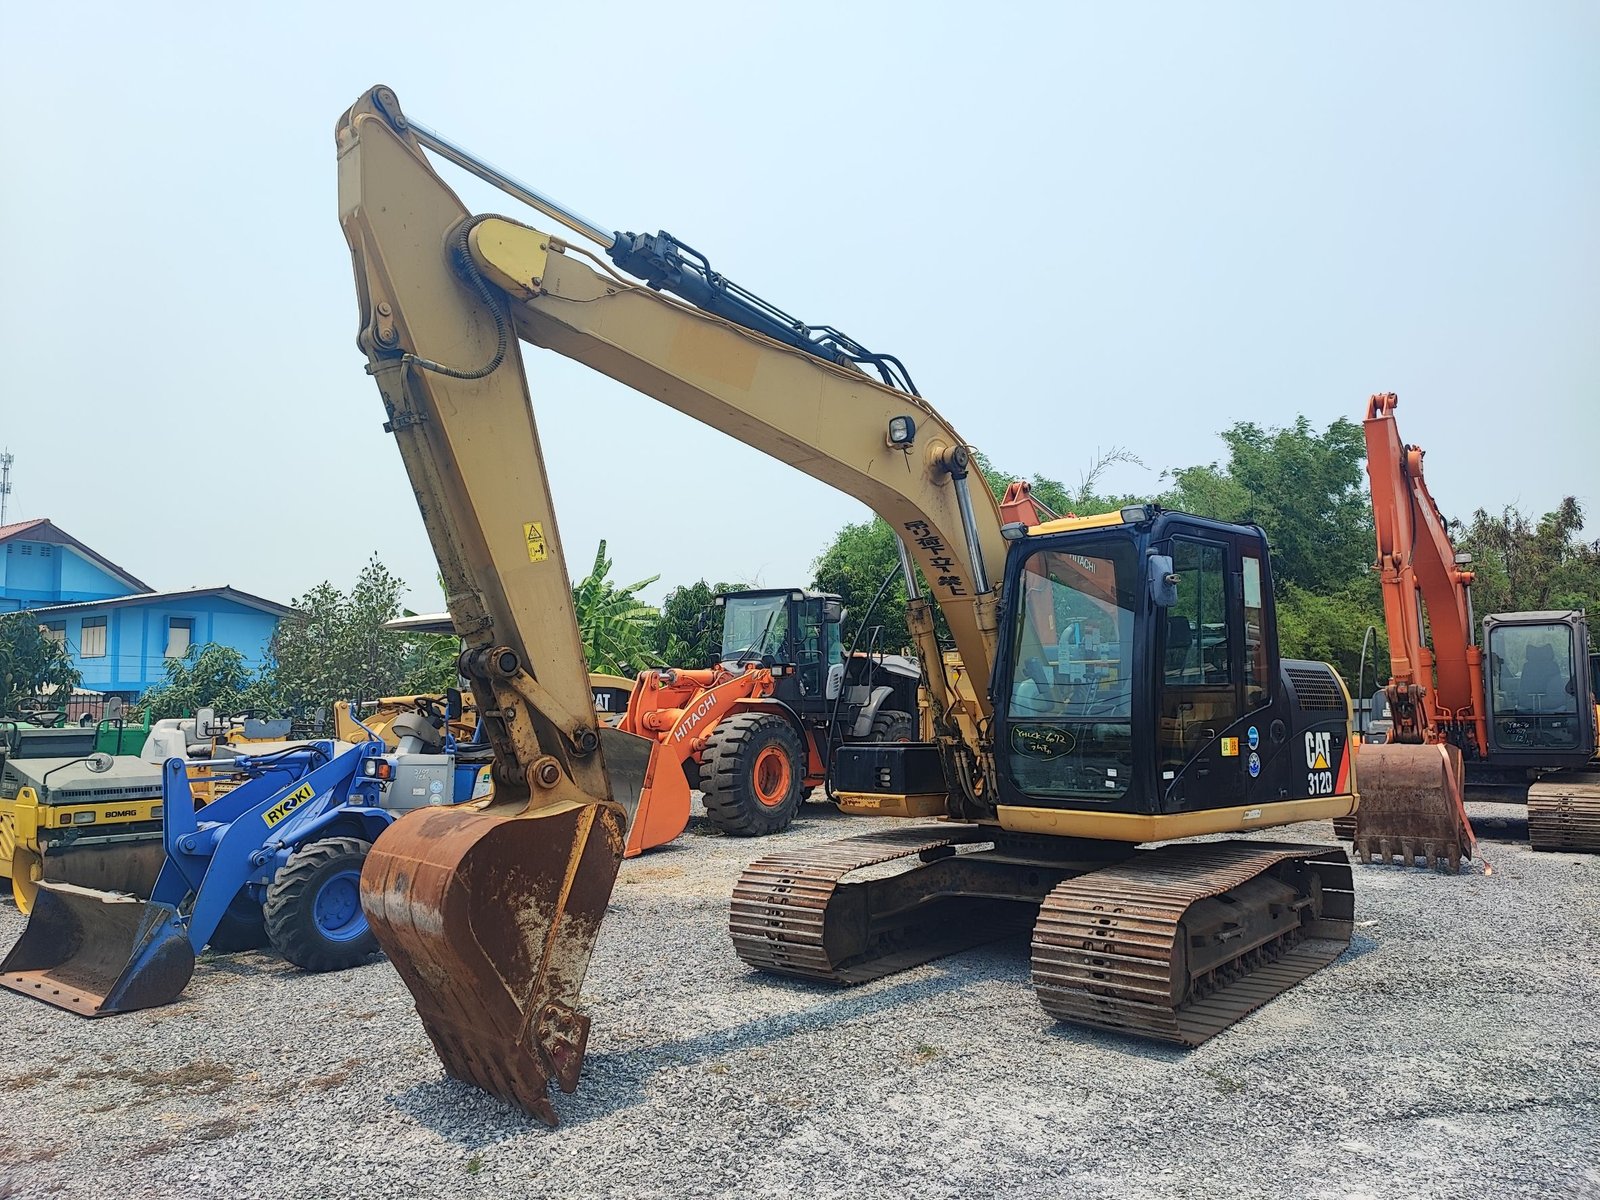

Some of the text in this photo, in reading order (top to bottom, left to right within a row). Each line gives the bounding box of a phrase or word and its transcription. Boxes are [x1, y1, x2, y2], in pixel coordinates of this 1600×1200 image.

[592, 693, 611, 711] AT
[674, 693, 717, 742] HITACHI
[1305, 731, 1331, 769] CAT
[1307, 771, 1333, 795] 312D
[105, 810, 137, 818] BOMAG
[267, 787, 311, 824] RYOKI
